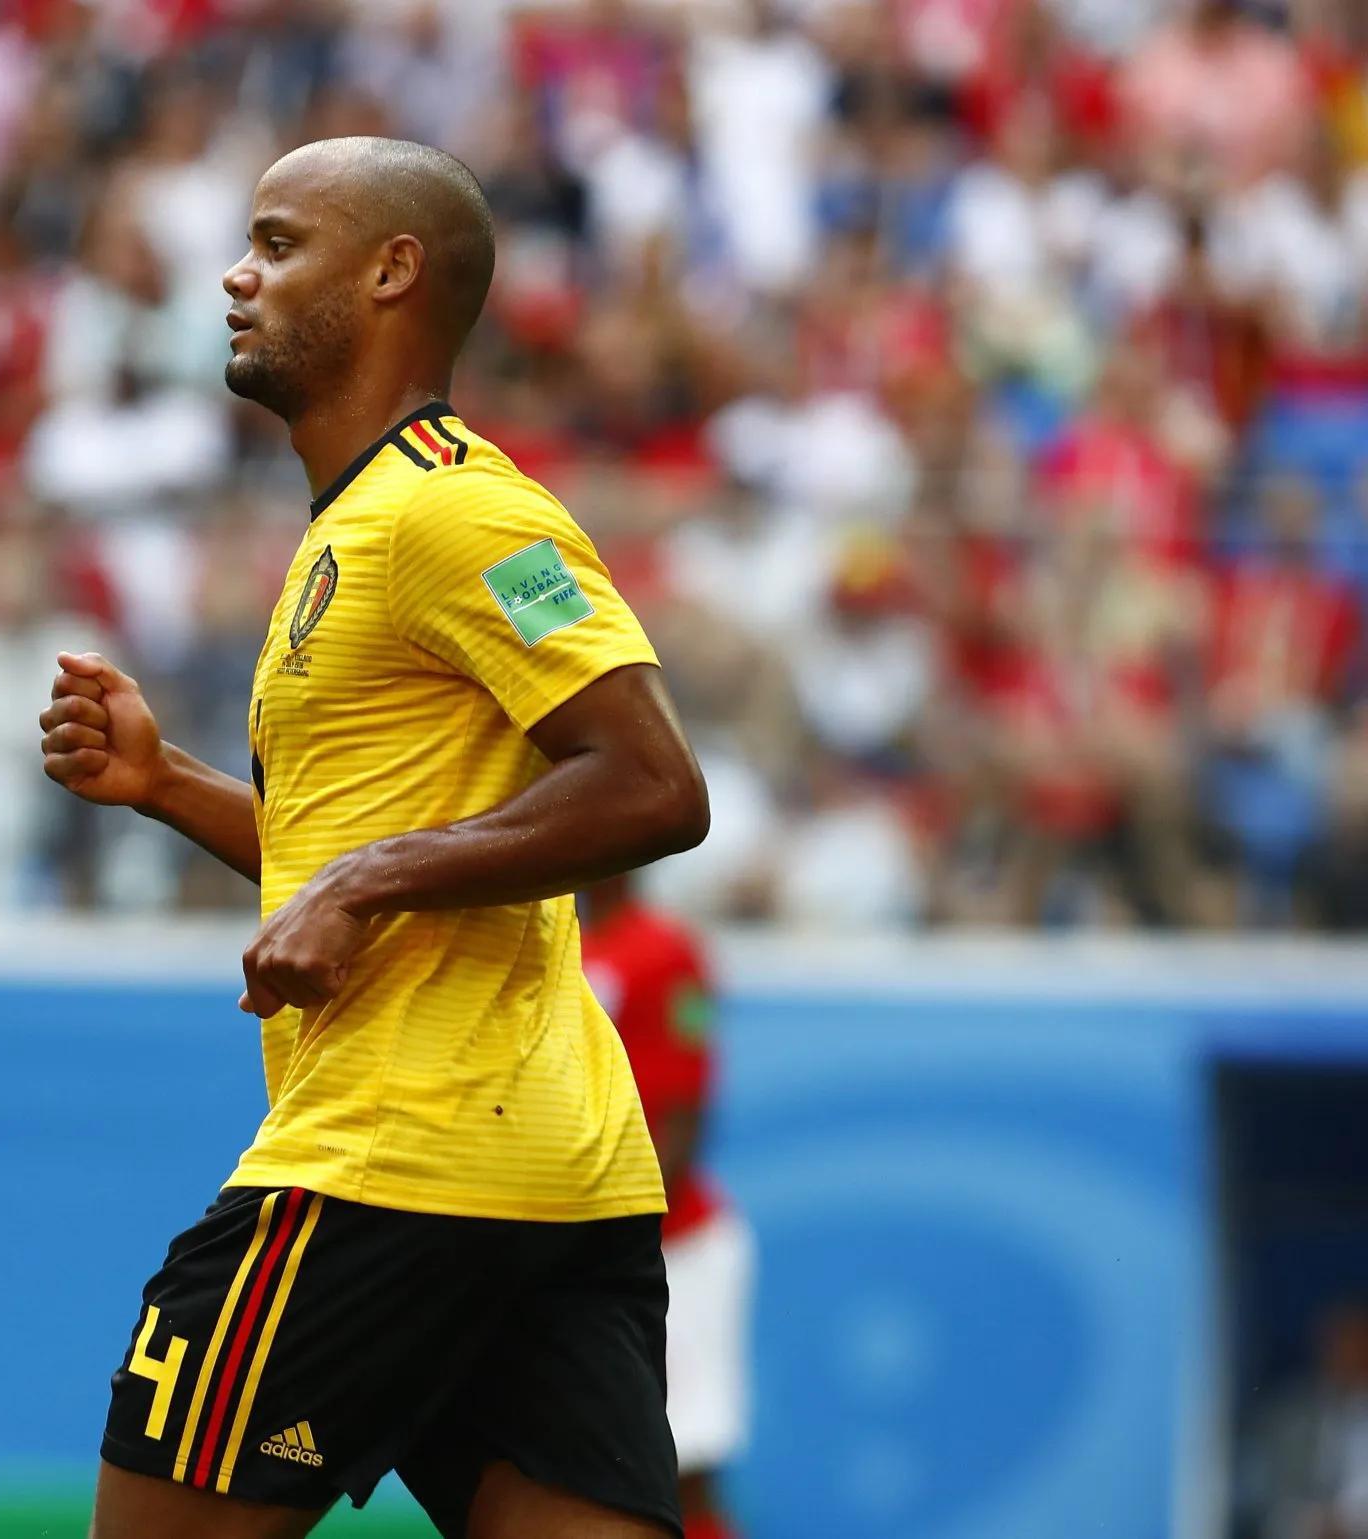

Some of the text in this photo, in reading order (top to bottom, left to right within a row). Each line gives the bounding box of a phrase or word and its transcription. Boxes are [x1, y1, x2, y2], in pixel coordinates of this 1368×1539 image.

[501, 563, 561, 601] LIVING
[552, 587, 577, 605] FIFA
[128, 1304, 189, 1441] 4
[260, 1441, 323, 1467] adidas
